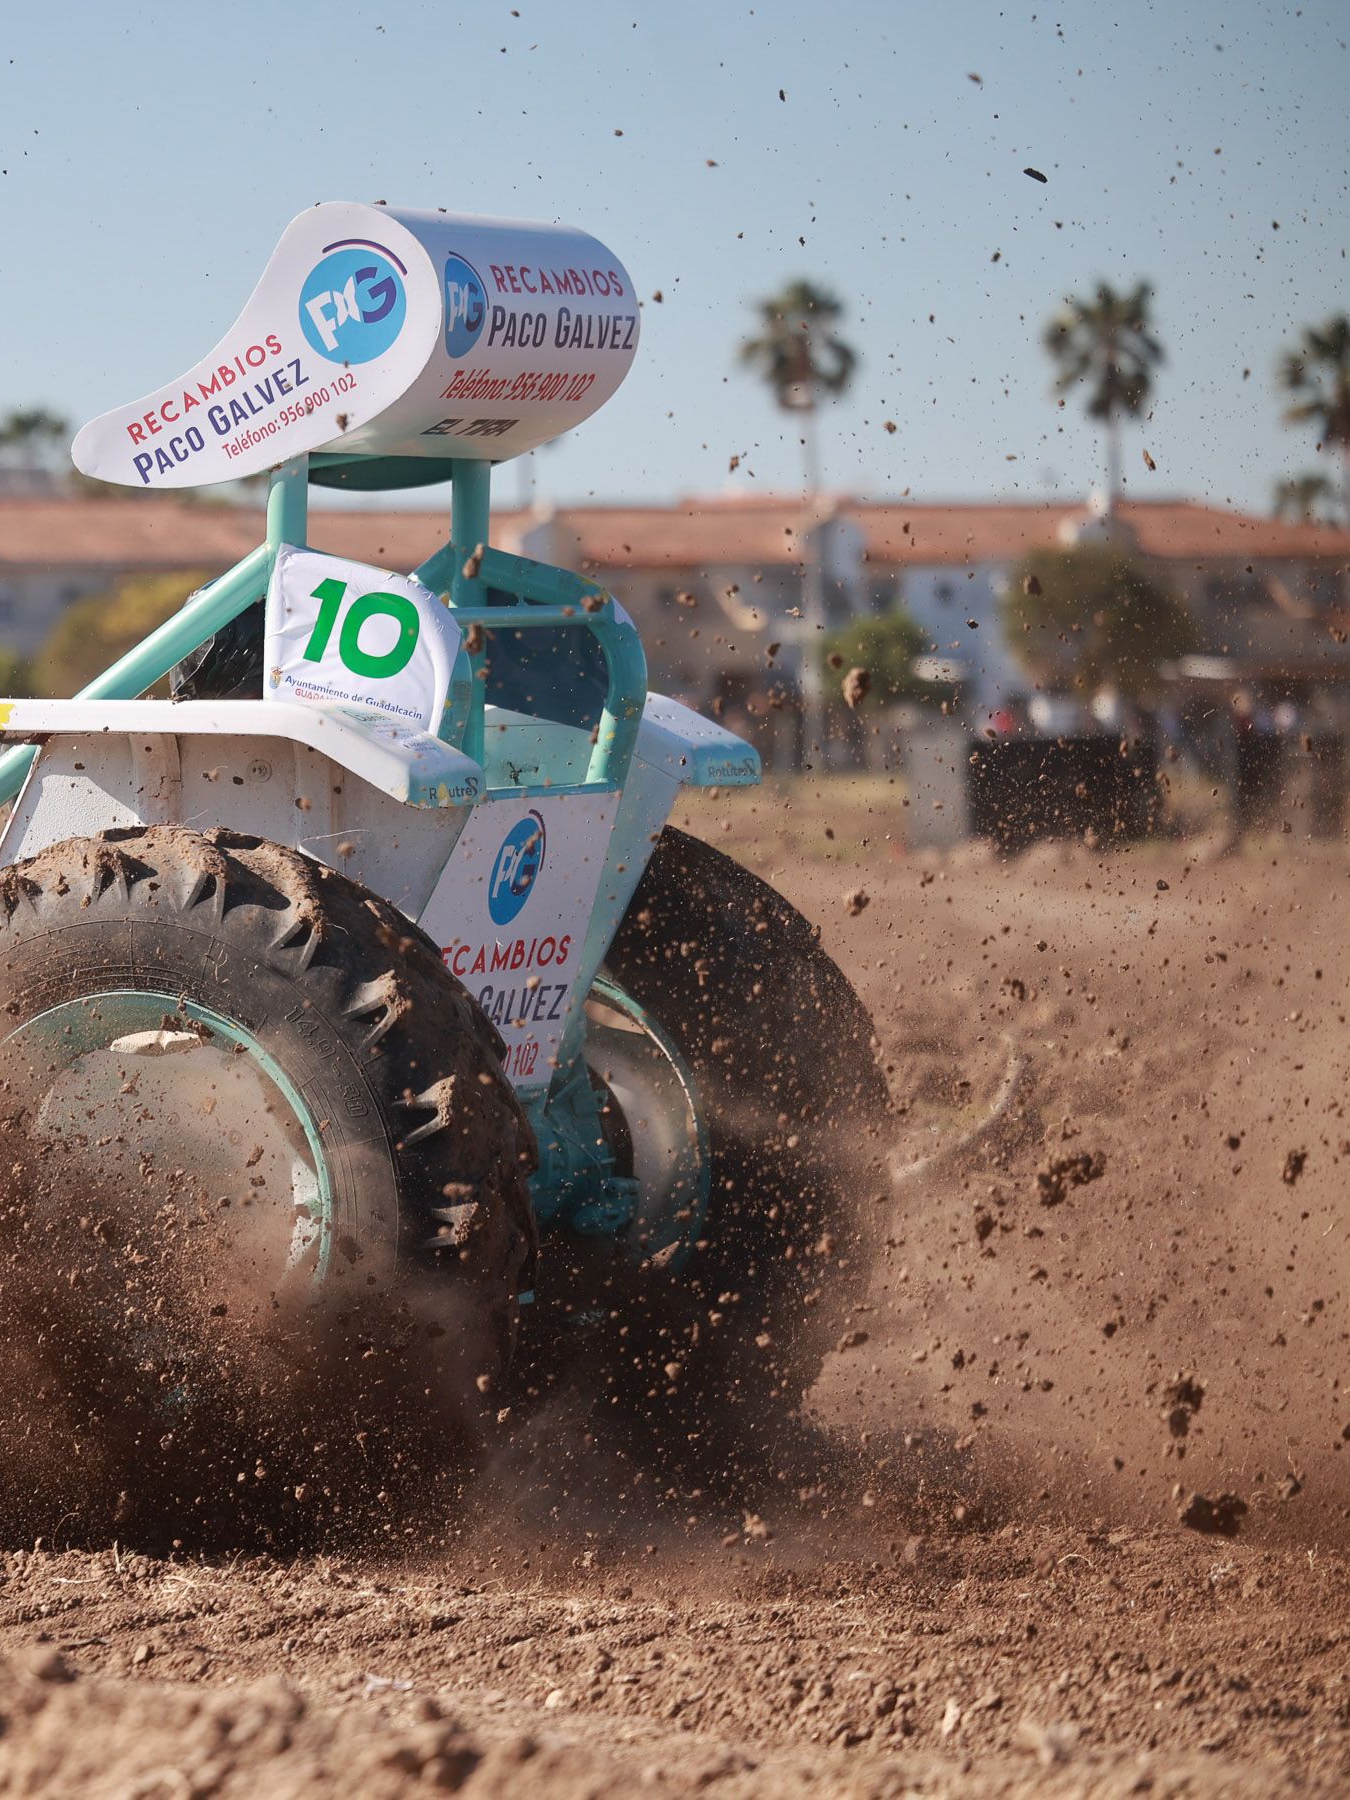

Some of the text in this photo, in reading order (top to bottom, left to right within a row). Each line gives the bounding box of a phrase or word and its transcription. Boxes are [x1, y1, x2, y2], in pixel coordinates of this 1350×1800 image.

[489, 265, 624, 297] RECAMBIOS
[487, 305, 636, 350] PACO GALVEZ
[126, 334, 283, 446] RECAMBIOS
[439, 368, 596, 402] Teléfono: 956 900 102
[132, 358, 310, 485] PACO GALVEZ
[221, 371, 358, 461] Teléfono: 956 900 102
[419, 418, 465, 436] EL
[302, 577, 420, 680] 10
[284, 675, 350, 700] Ayuntamiento
[351, 693, 363, 703] de
[513, 1042, 539, 1077] 102
